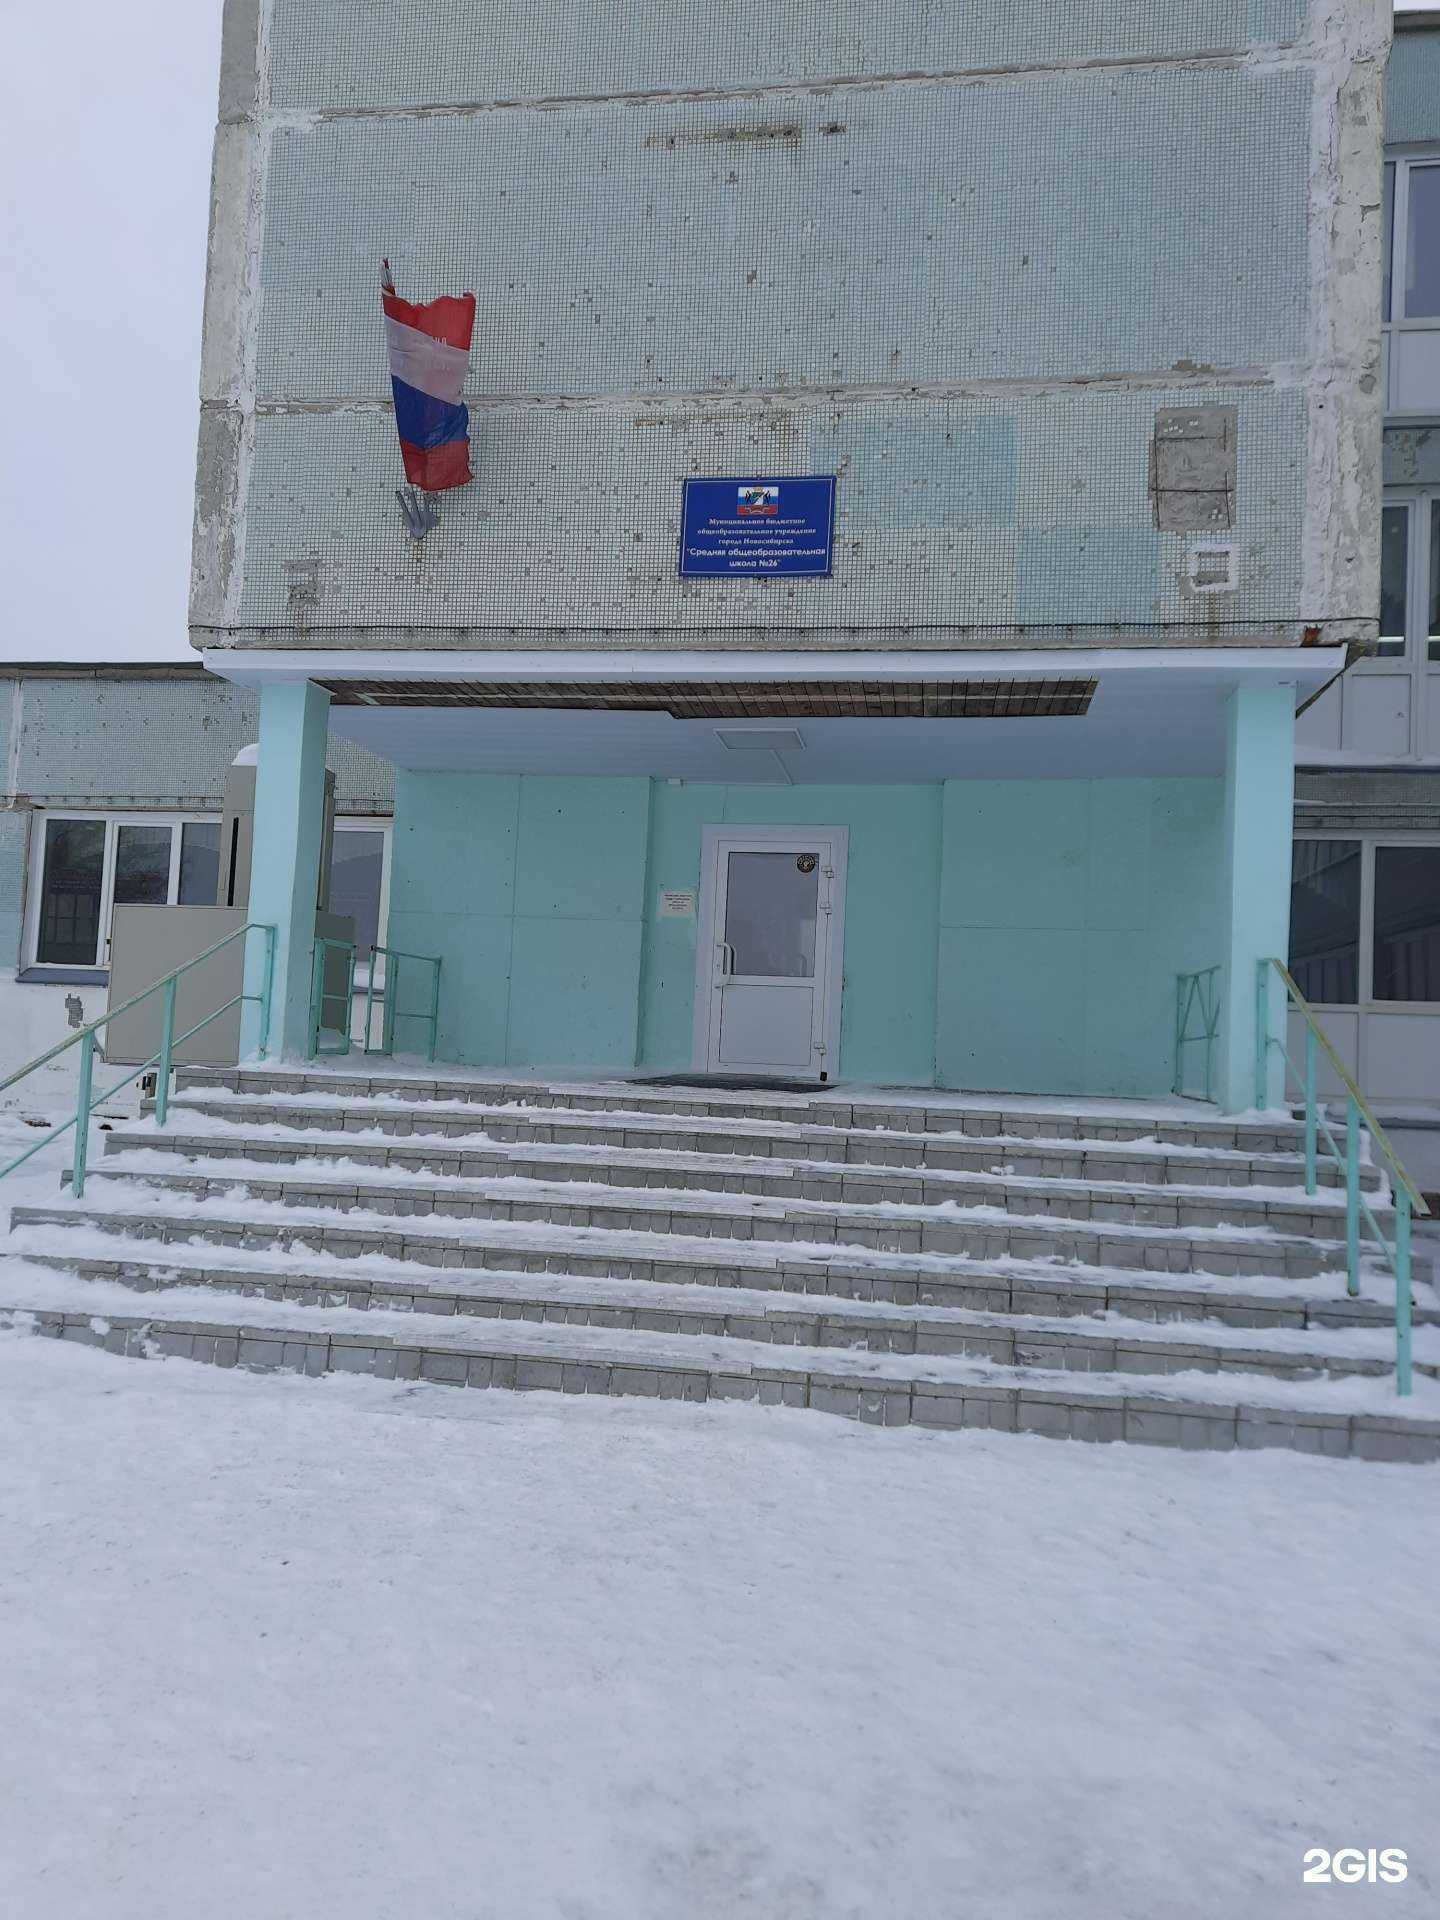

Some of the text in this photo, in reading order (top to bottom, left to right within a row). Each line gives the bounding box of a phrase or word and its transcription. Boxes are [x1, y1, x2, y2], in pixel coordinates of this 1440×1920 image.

[709, 517, 806, 526] Муниципальное бюджетное
[697, 528, 773, 536] общеобразовательное
[718, 537, 794, 546] города Новосибирска
[728, 547, 826, 558] общеобразовательная
